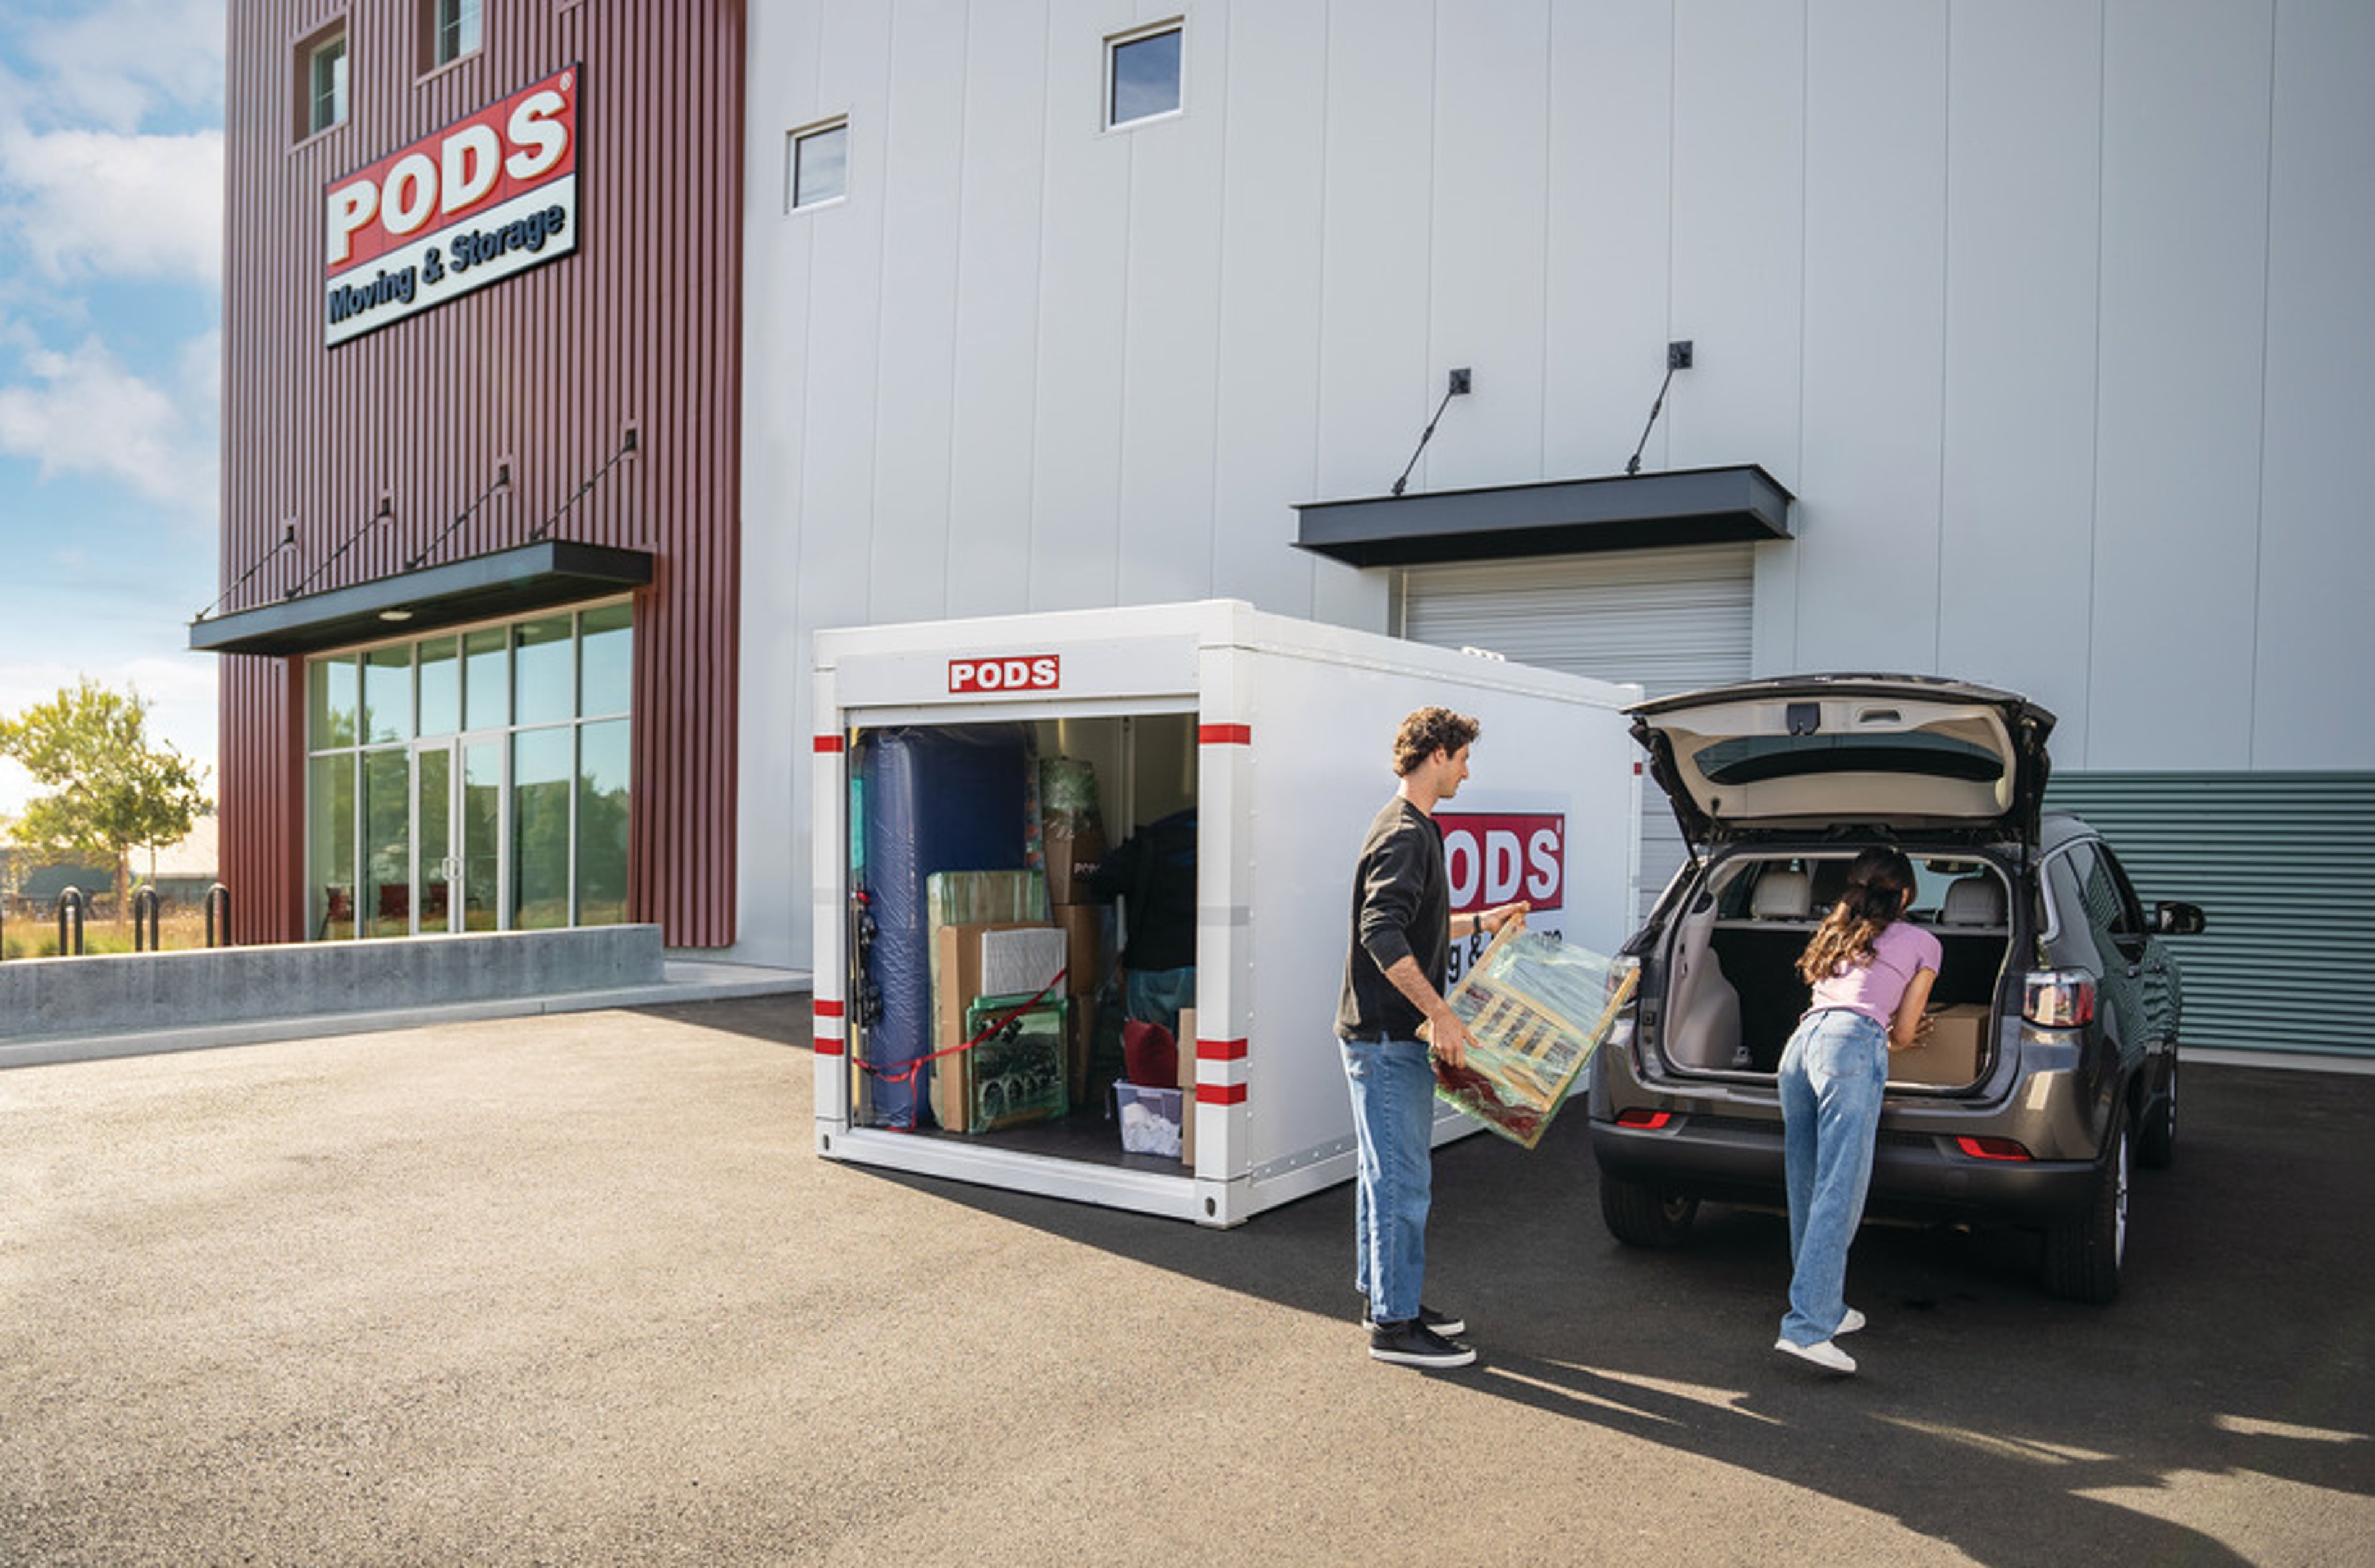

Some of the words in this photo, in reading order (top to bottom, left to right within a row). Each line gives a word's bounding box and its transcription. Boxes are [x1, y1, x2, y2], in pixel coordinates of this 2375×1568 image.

[328, 91, 567, 266] PODS
[328, 265, 415, 324] Moving
[421, 247, 445, 284] &
[450, 205, 565, 273] Storage
[951, 660, 1056, 689] PODS
[1444, 829, 1560, 908] ODS
